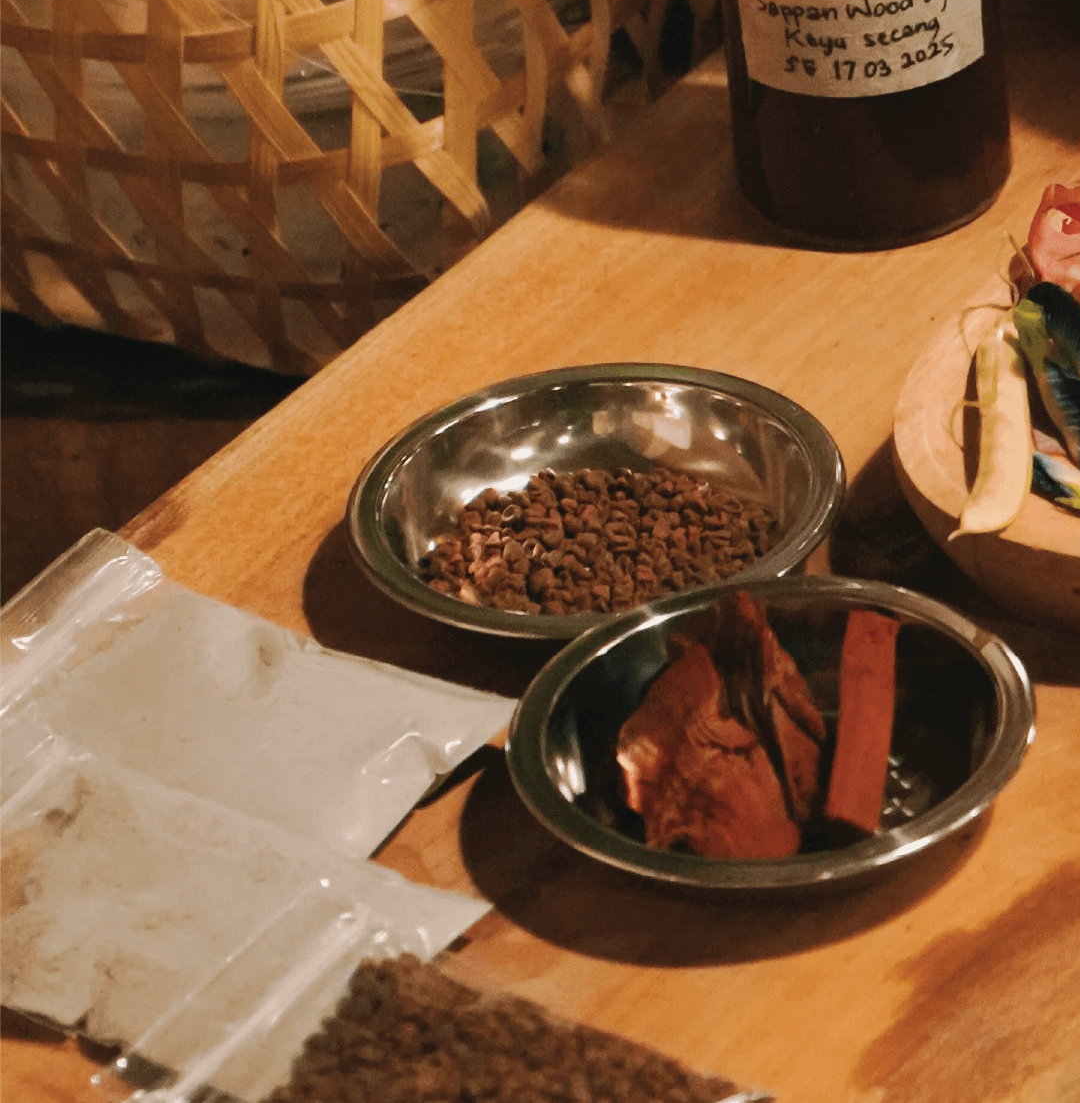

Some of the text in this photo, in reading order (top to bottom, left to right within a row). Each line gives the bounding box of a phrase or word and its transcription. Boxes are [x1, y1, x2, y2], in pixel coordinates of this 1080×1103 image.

[833, 59, 856, 81] 17
[864, 60, 892, 78] 03
[901, 33, 955, 69] 2025
